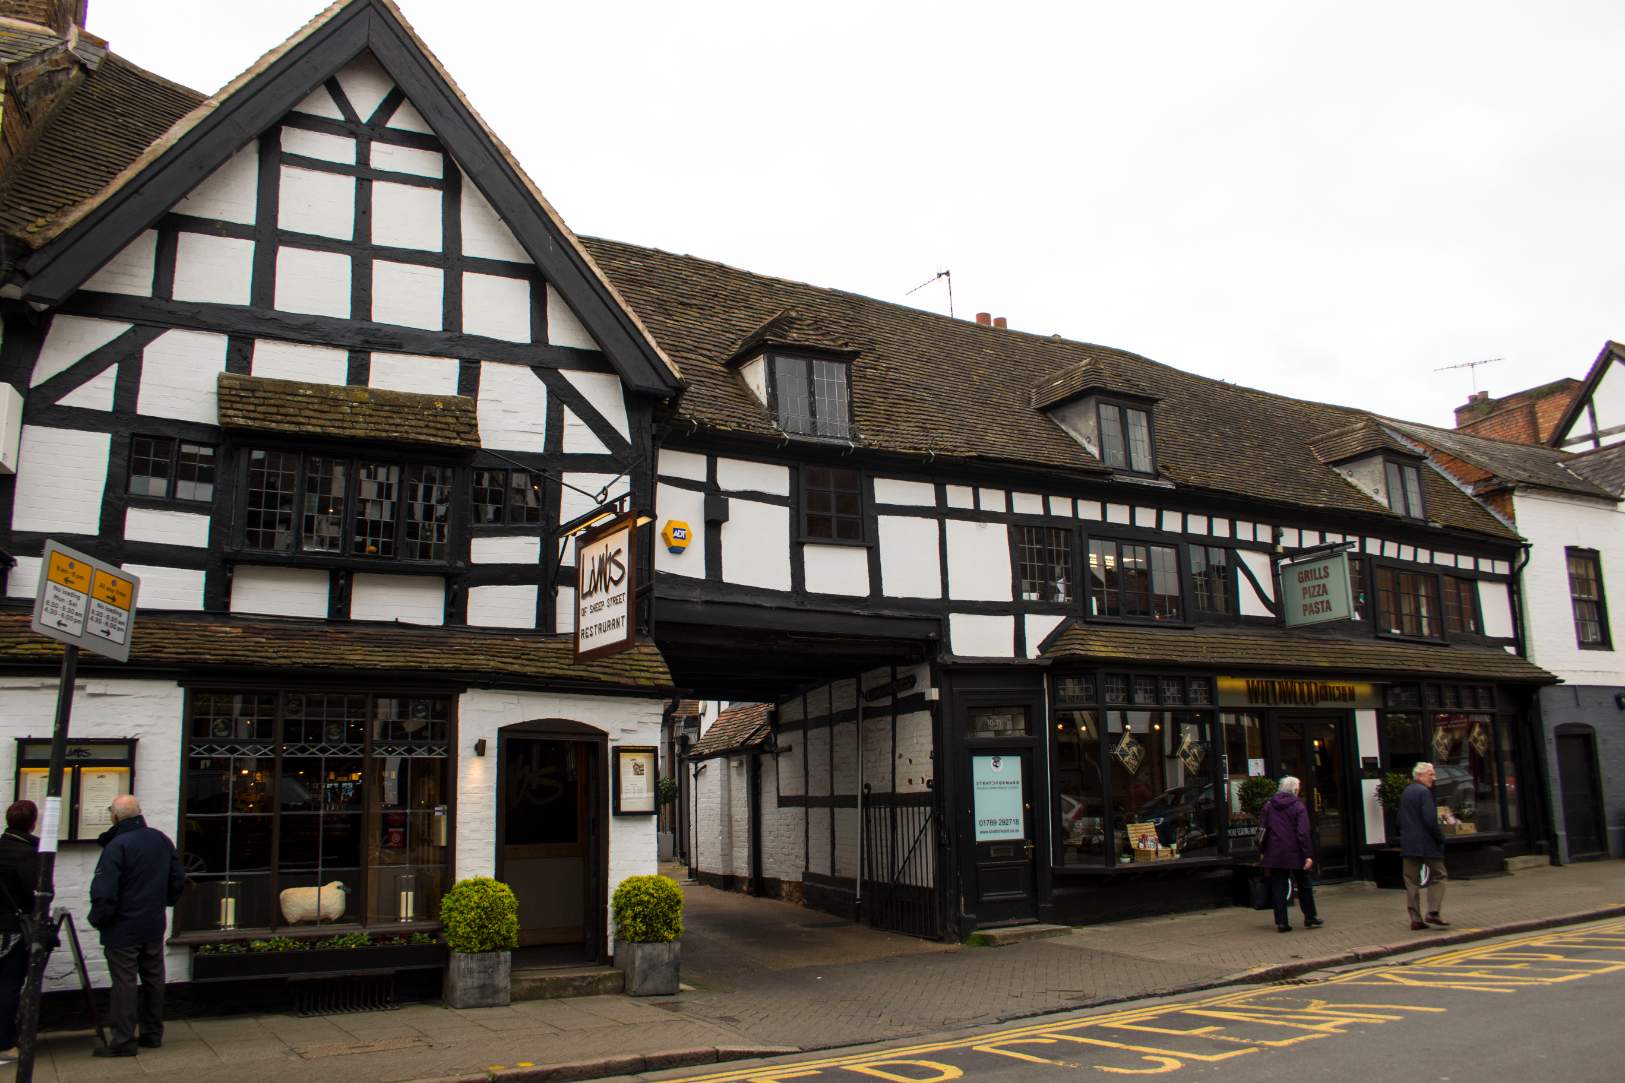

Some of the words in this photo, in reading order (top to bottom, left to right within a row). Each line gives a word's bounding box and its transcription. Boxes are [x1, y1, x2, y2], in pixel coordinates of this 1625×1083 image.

[673, 528, 686, 539] ADT
[1297, 565, 1329, 583] GRILLS
[62, 588, 81, 600] loading
[1302, 583, 1328, 600] PIZZA
[581, 607, 587, 617] OF
[589, 602, 605, 614] SHEEP
[607, 592, 626, 608] STREET
[1302, 600, 1332, 617] PASTA
[581, 615, 626, 639] RESTAURANT
[1246, 679, 1318, 705] WILDWOOD
[978, 818, 997, 827] 01789
[998, 817, 1020, 826] 292718
[971, 997, 1446, 1075] CLEAR
